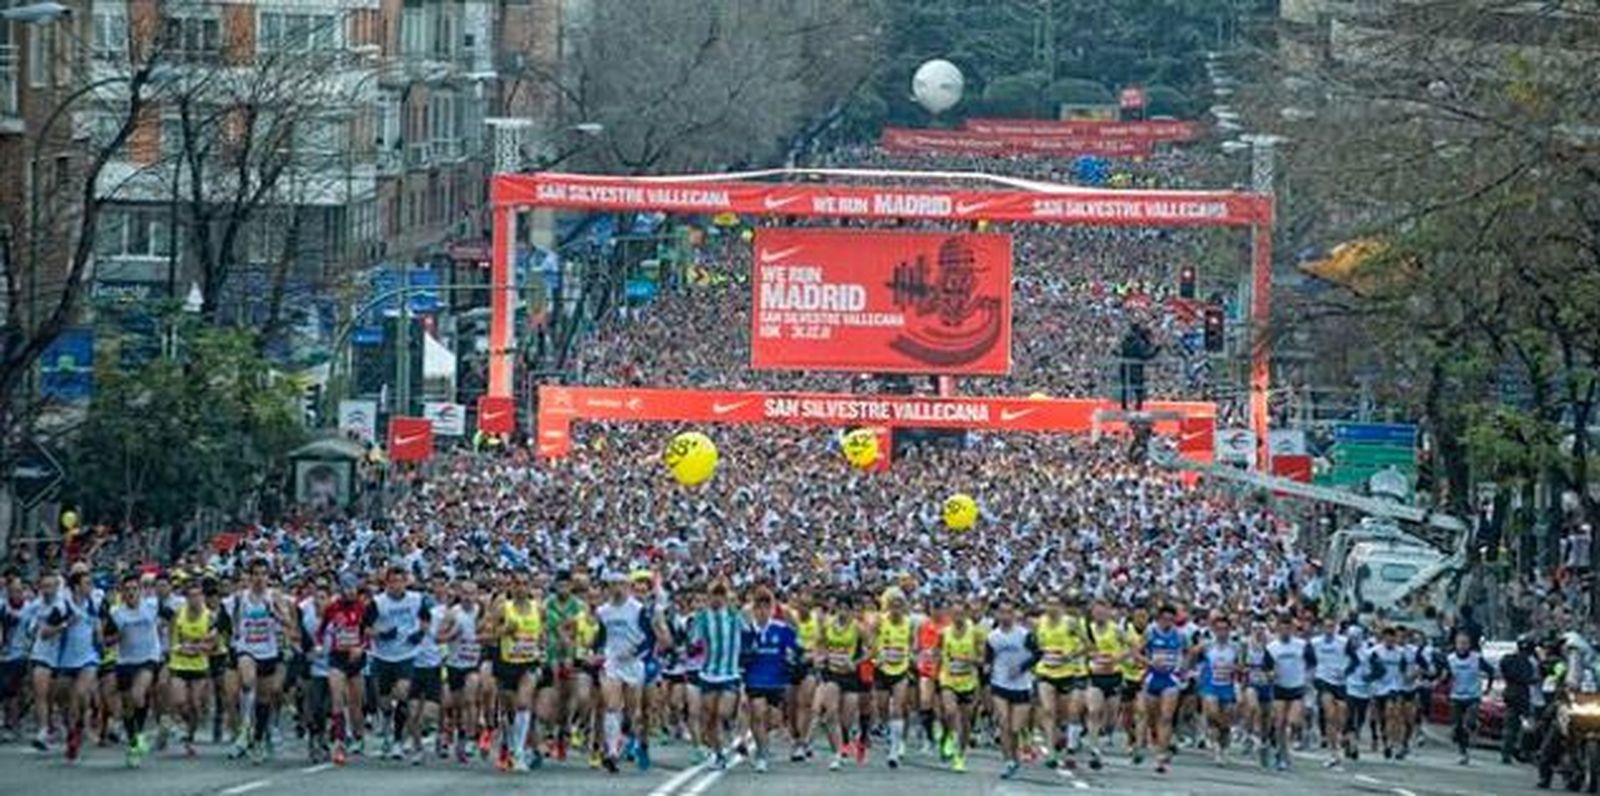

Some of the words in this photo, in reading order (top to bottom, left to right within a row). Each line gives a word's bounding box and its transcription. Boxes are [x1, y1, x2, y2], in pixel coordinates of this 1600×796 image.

[536, 184, 568, 199] SAN
[570, 184, 644, 204] SILVESTRE
[645, 188, 730, 207] VALLECANA
[873, 194, 952, 216] MADRID
[1033, 201, 1064, 216] SAN
[1144, 201, 1229, 219] VALLECANA
[761, 265, 787, 283] WE
[788, 266, 822, 283] RUN
[760, 282, 866, 311] MADRID
[760, 312, 781, 324] SAN
[782, 312, 840, 326] SILVESTRE
[842, 313, 905, 326] VALLECANA
[764, 398, 799, 417] SAN
[802, 398, 890, 419] SILVESTRE
[892, 401, 989, 421] VALLECANA
